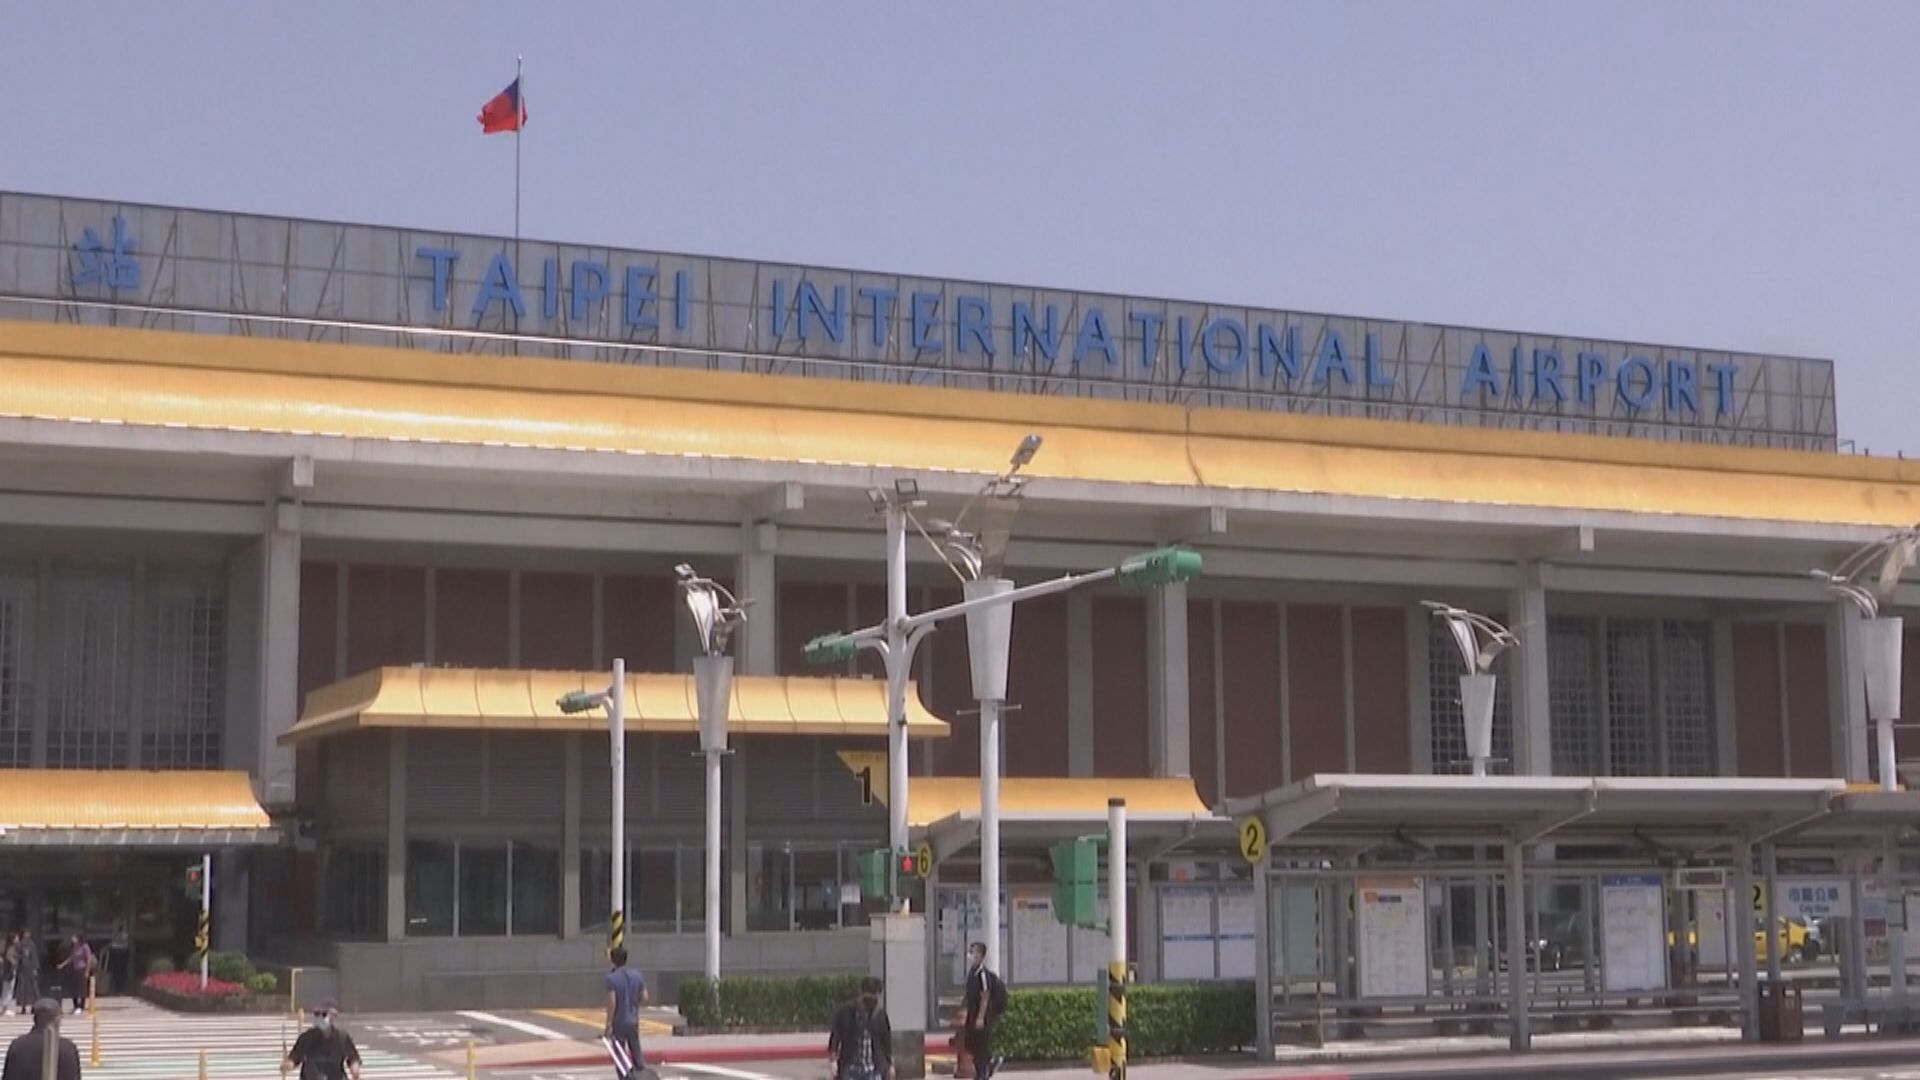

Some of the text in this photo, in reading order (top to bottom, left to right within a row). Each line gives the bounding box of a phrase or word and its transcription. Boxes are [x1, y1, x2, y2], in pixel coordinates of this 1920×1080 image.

[73, 216, 139, 288] 站
[416, 246, 1738, 415] TAIPEI INTERNATIONAL AIRPORT
[855, 766, 871, 804] 1
[1246, 823, 1259, 856] 2
[919, 847, 928, 873] 6
[1752, 885, 1763, 910] 2
